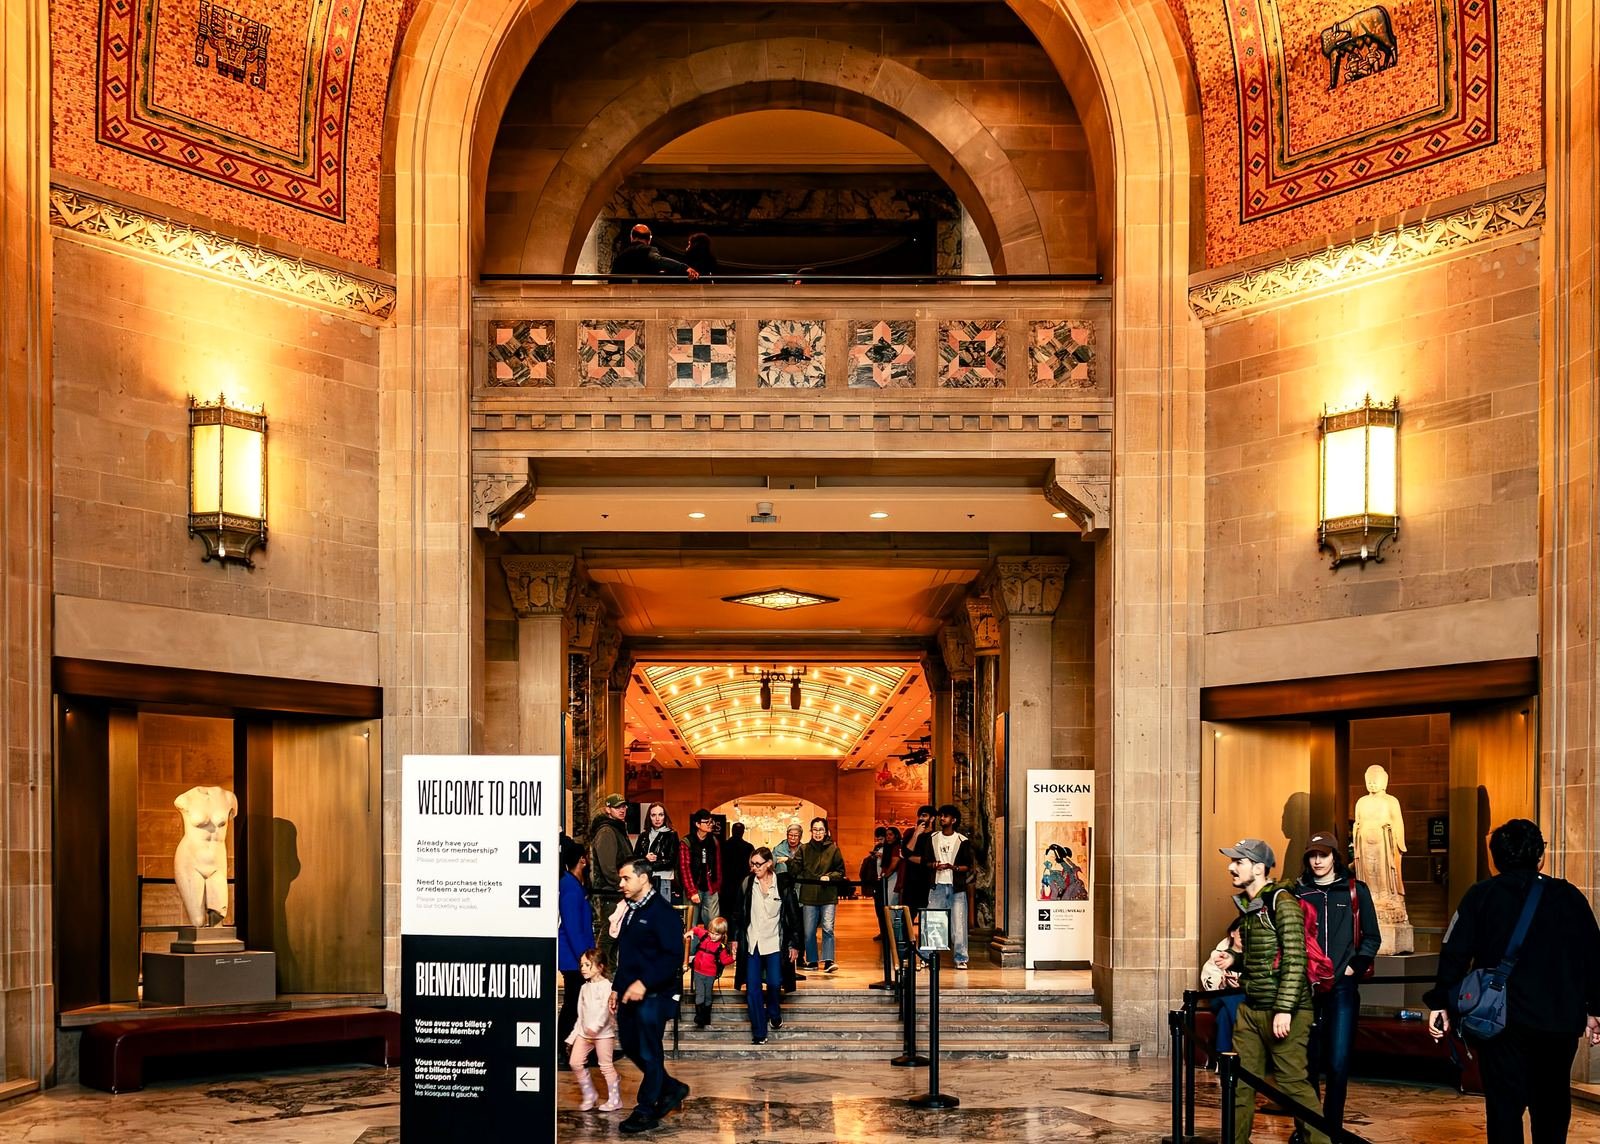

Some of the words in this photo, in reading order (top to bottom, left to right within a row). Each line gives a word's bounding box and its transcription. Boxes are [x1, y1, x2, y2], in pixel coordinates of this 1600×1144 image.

[1033, 784, 1091, 793] SHOKKAN
[418, 780, 484, 816] WELCOME
[488, 781, 504, 816] TO
[509, 781, 542, 816] ROM
[417, 840, 443, 848] Already
[451, 847, 498, 855] membership?
[415, 961, 486, 998] BIENVENUE
[488, 963, 506, 998] AU
[509, 964, 541, 999] ROM
[415, 1019, 433, 1027] Vous
[464, 1020, 487, 1028] billets
[415, 1026, 433, 1034] Vous
[450, 1027, 480, 1035] Membre
[481, 1028, 486, 1036] ?
[415, 1058, 433, 1066] Vous
[433, 1059, 457, 1067] voulez
[462, 1067, 487, 1075] utiliser
[424, 1090, 450, 1098] kiosques
